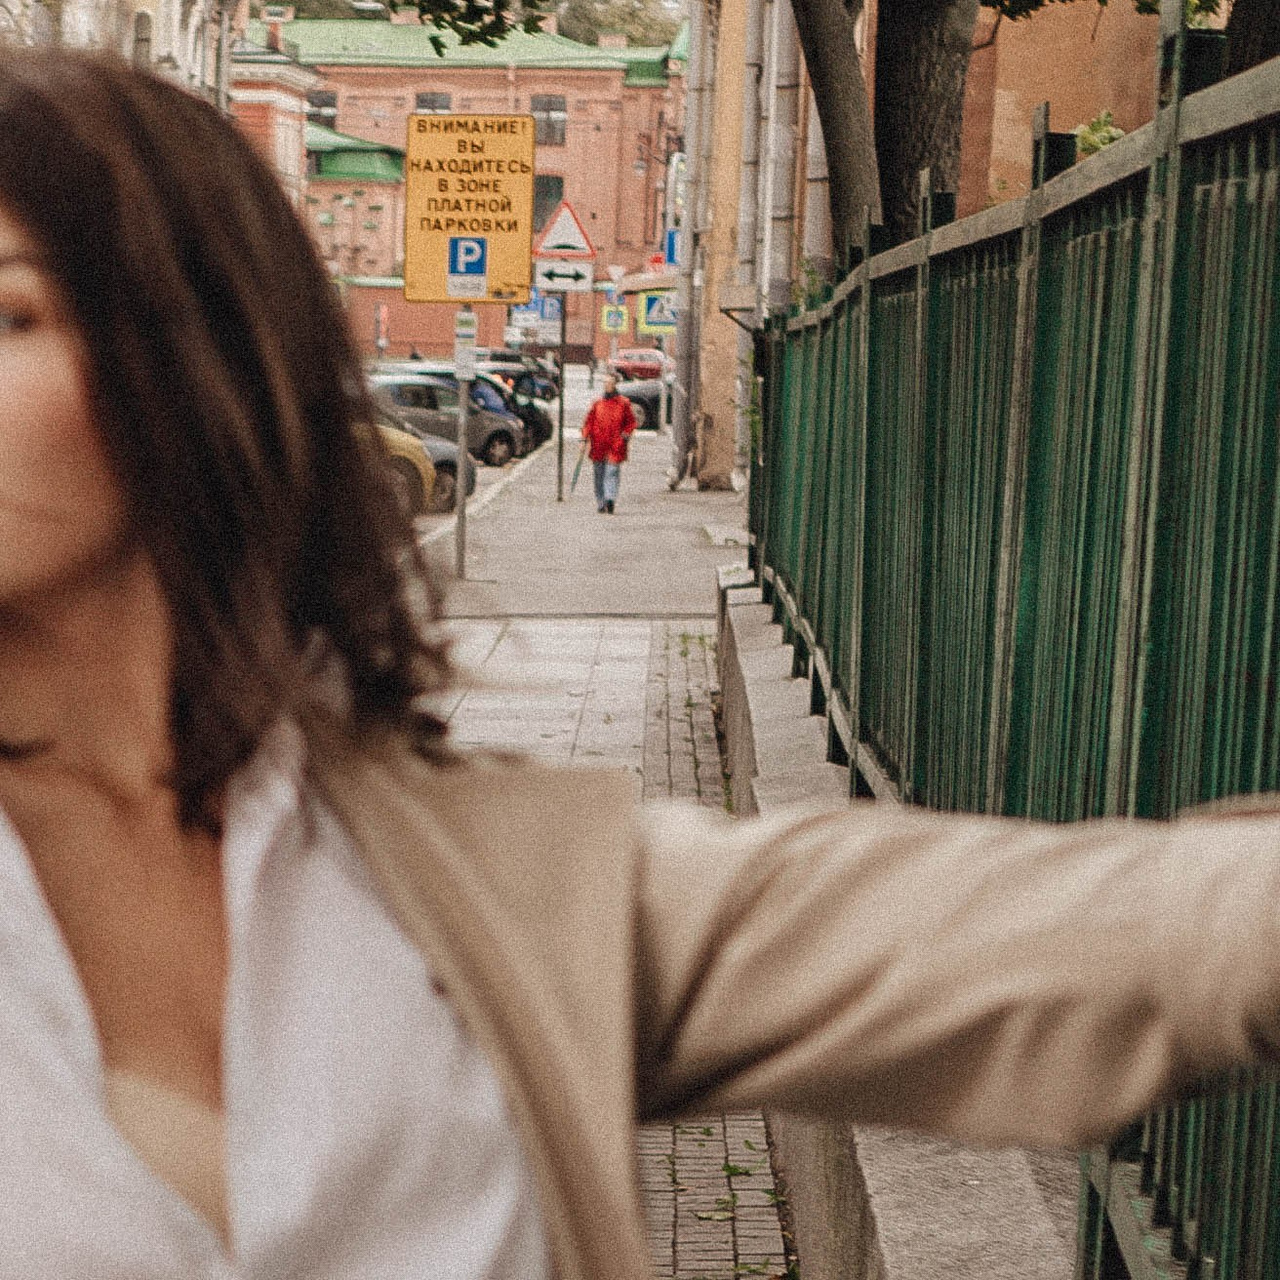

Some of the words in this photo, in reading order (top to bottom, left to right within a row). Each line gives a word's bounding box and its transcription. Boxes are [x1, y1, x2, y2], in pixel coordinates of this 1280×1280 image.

[417, 119, 527, 134] ВНИМАНИЕ!
[457, 139, 485, 153] ВЫ
[409, 158, 531, 174] НАХОДИТЕСЬ
[438, 178, 449, 193] В
[456, 178, 502, 193] ЗОНЕ
[427, 195, 512, 213] ПЛАТНОЙ
[420, 217, 519, 232] ПАРКОВКИ
[457, 239, 482, 273] P
